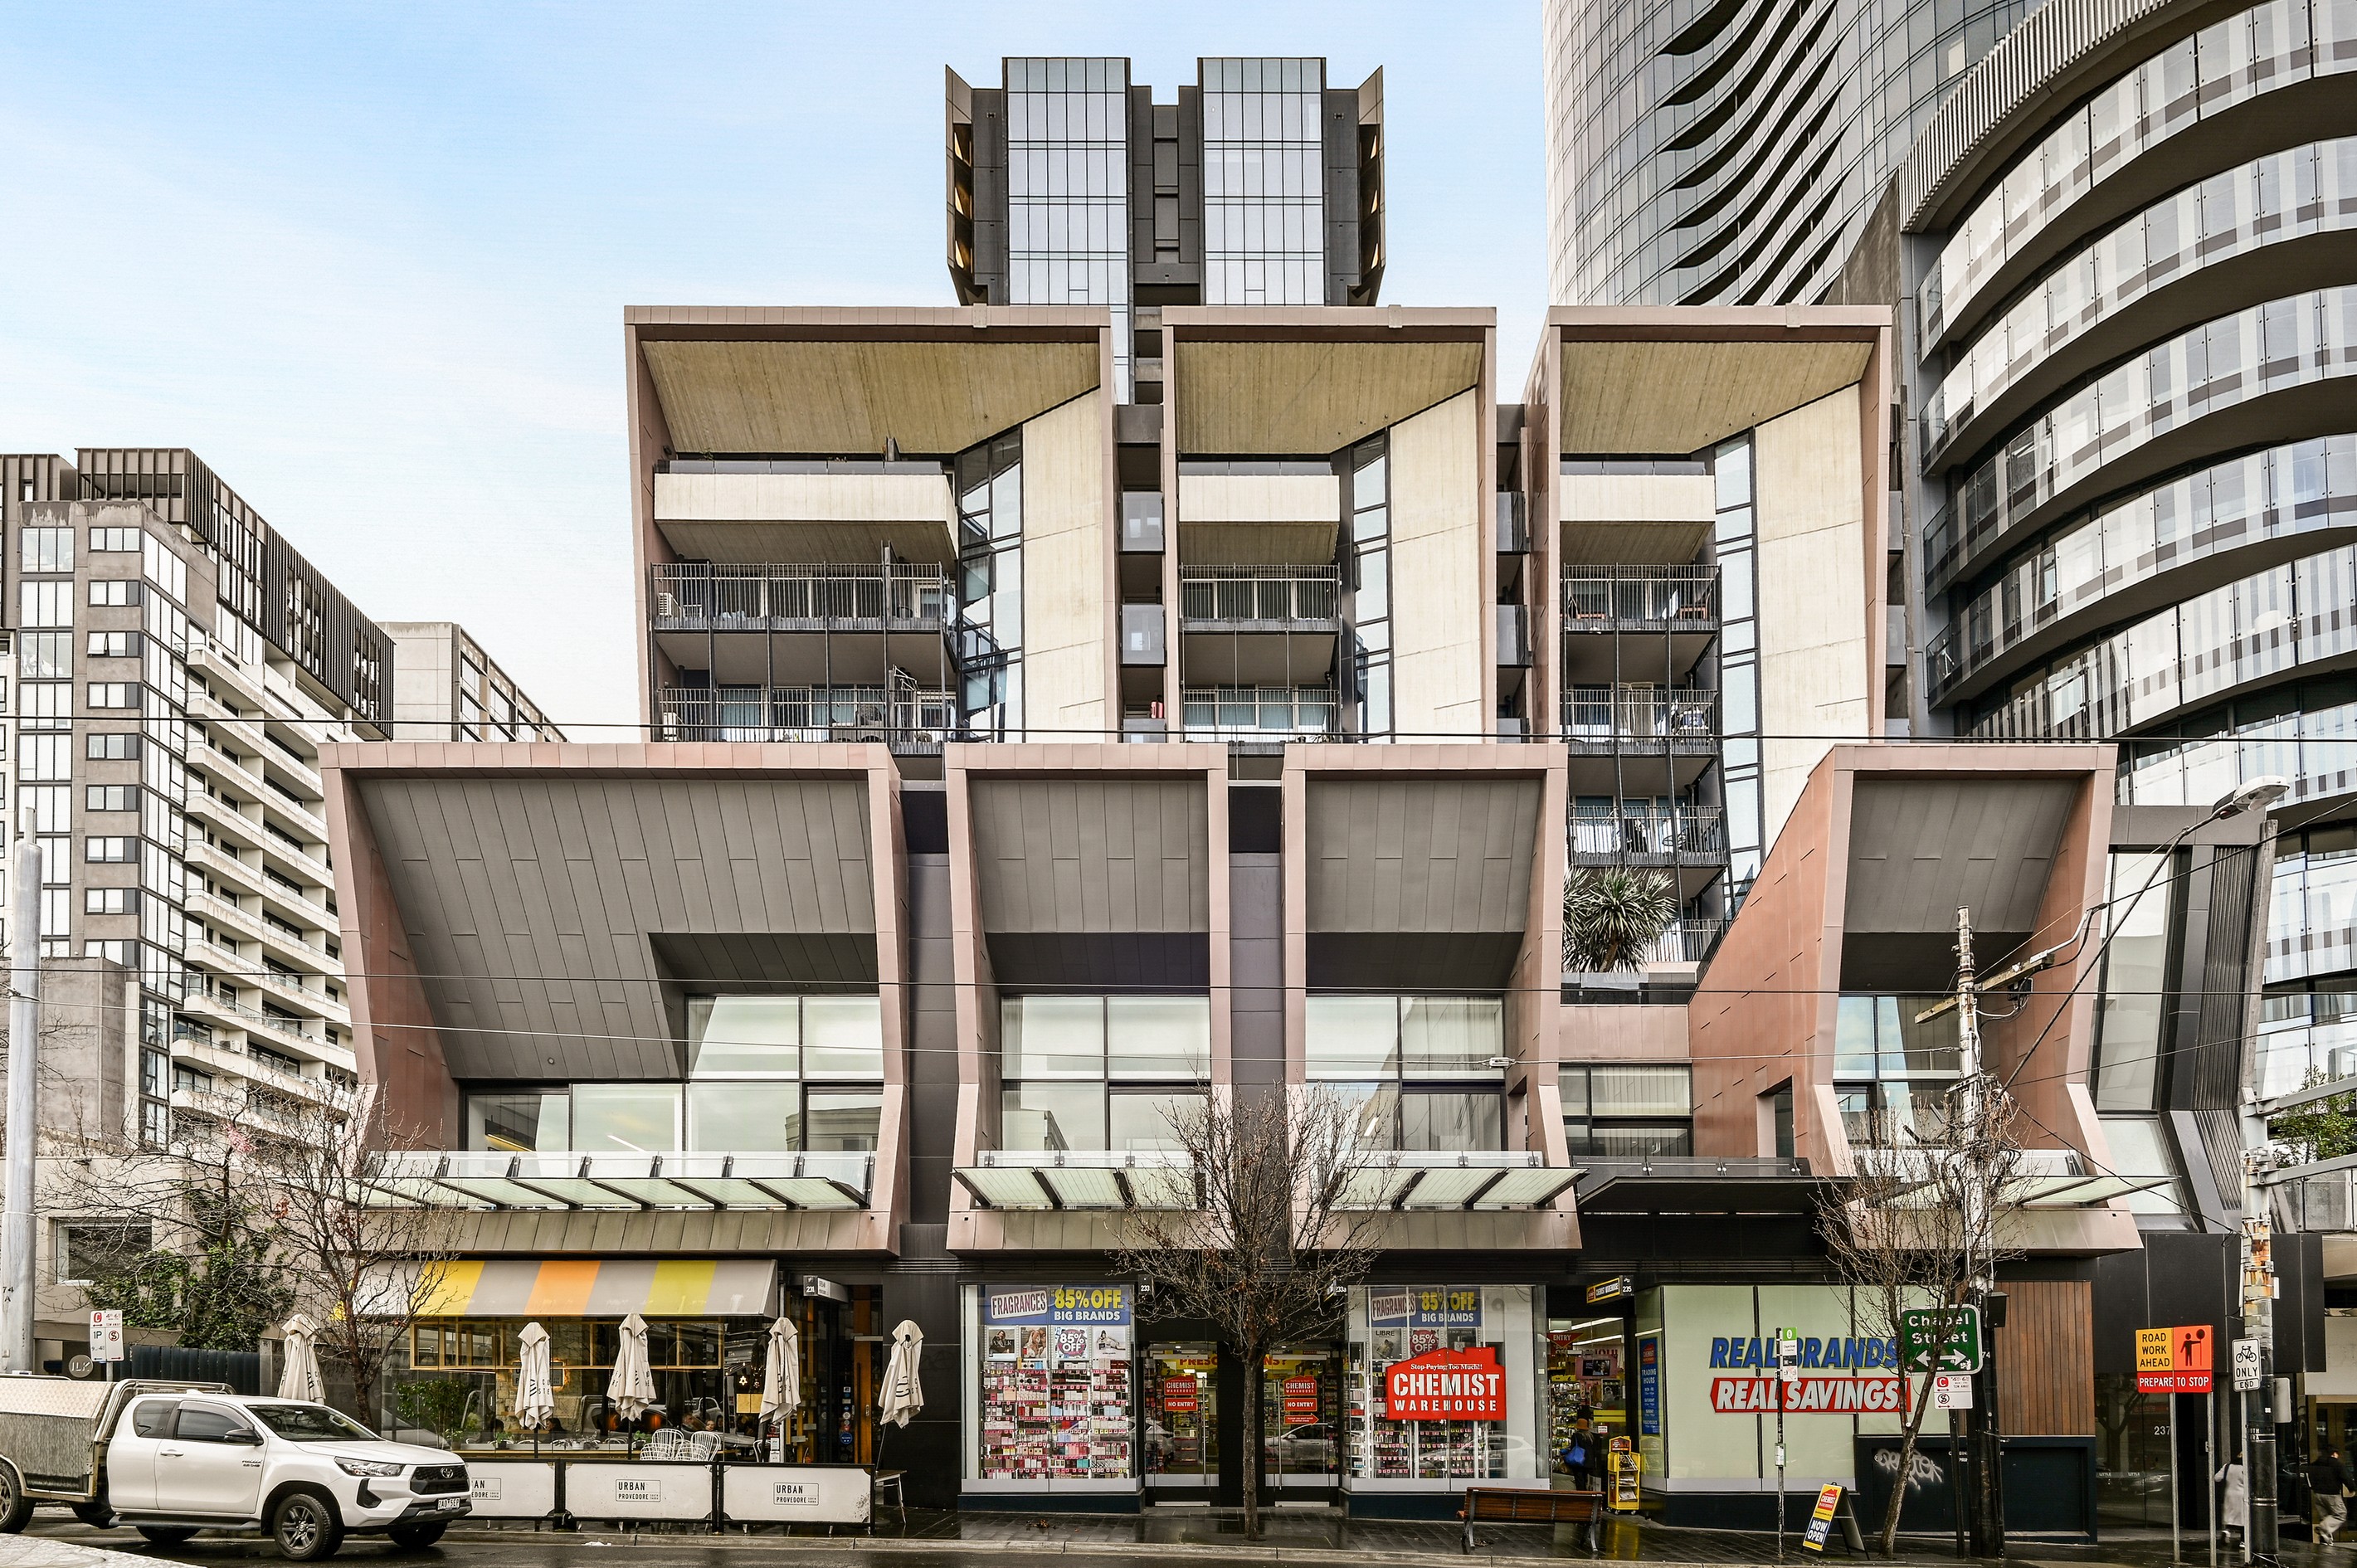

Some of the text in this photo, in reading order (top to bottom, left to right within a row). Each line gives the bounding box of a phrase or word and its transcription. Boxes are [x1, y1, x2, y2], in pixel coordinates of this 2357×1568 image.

[991, 1293, 1046, 1316] FRAGRANCES
[1054, 1289, 1122, 1309] 85% OFF
[1421, 1291, 1475, 1311] 85% OFF
[1054, 1311, 1121, 1321] BIG BRANDS
[1421, 1312, 1437, 1322] BIG
[1908, 1312, 1970, 1327] Chapel
[93, 1331, 103, 1340] 1P
[1059, 1332, 1084, 1344] 85%
[1411, 1333, 1436, 1344] 85%
[2142, 1332, 2167, 1343] ROAD
[1062, 1342, 1081, 1352] OFF
[1415, 1343, 1433, 1352] OFF
[1709, 1337, 1778, 1368] REAL
[2141, 1345, 2167, 1355] WORK
[2140, 1358, 2170, 1367] AHEAD
[2236, 1367, 2257, 1377] ONLY
[1393, 1373, 1500, 1396] CHEMIST
[2139, 1376, 2209, 1387] PREPARE TO STOP
[1717, 1381, 1778, 1410] REAL
[1395, 1400, 1497, 1411] WAREHOUSE
[2154, 1425, 2171, 1435] 237
[618, 1482, 645, 1491] URBAN
[776, 1484, 803, 1494] URBAN
[1810, 1520, 1829, 1532] NOW
[1807, 1530, 1825, 1543] OPEN
